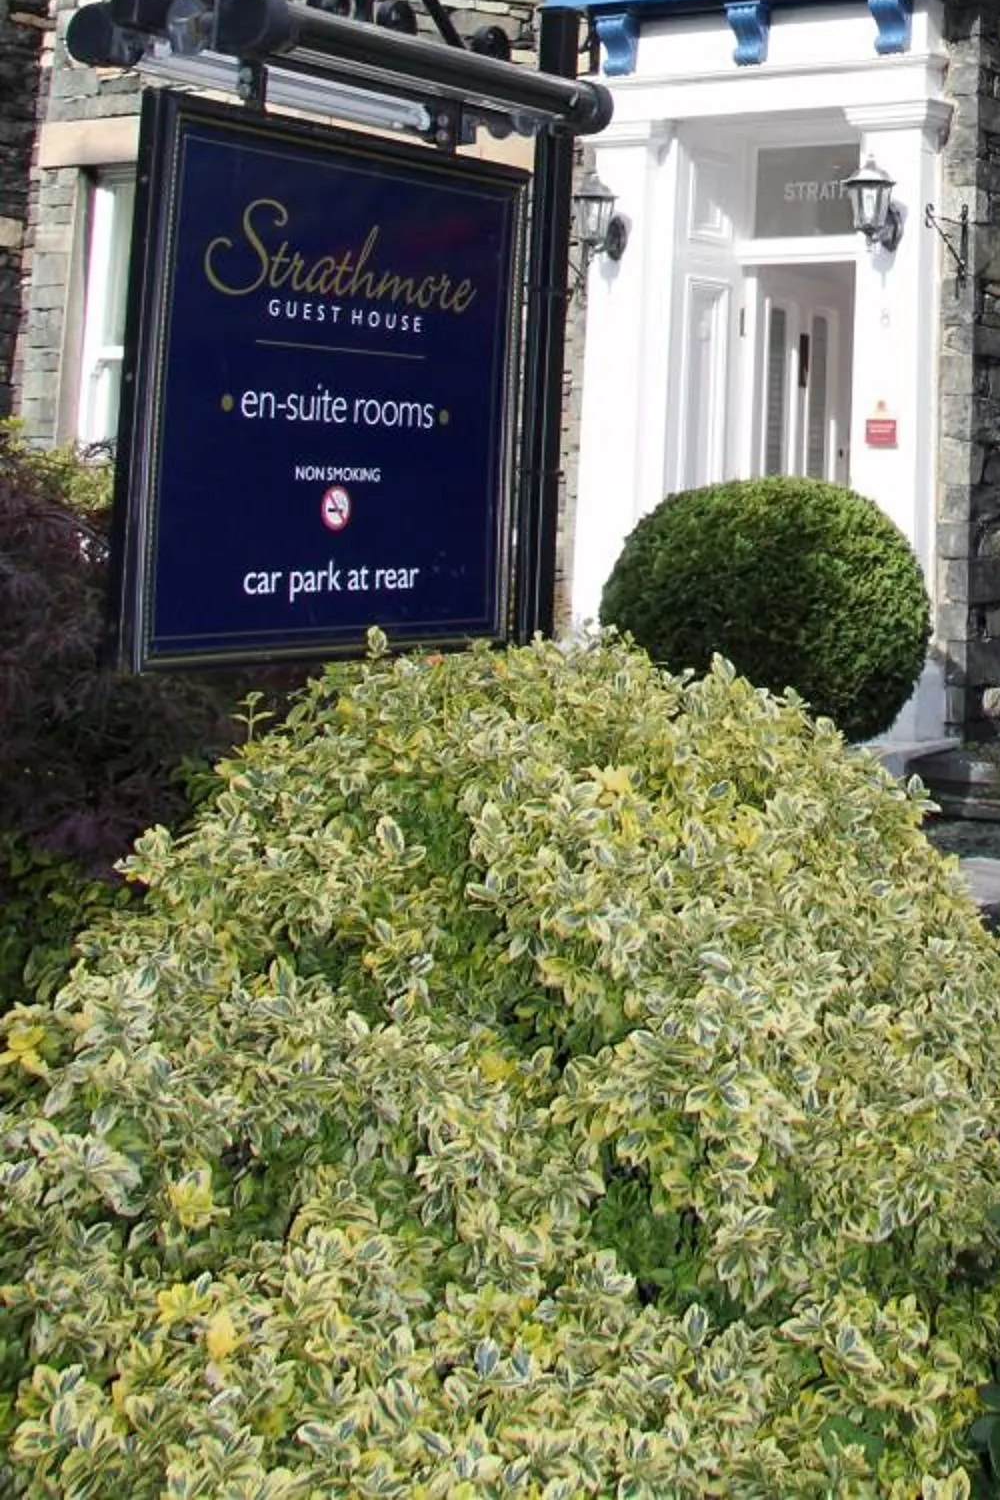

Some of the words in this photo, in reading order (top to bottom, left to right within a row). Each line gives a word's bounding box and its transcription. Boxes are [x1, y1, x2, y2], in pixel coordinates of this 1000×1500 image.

[204, 198, 477, 312] Strathmore
[267, 298, 342, 324] GUEST
[350, 308, 424, 334] HOUSE
[239, 383, 348, 425] en-suite
[353, 398, 435, 430] rooms
[294, 465, 325, 481] NON
[326, 466, 382, 483] SMOKING
[242, 570, 283, 596] car
[288, 560, 342, 603] park
[346, 564, 369, 592] at
[374, 566, 420, 591] rear
